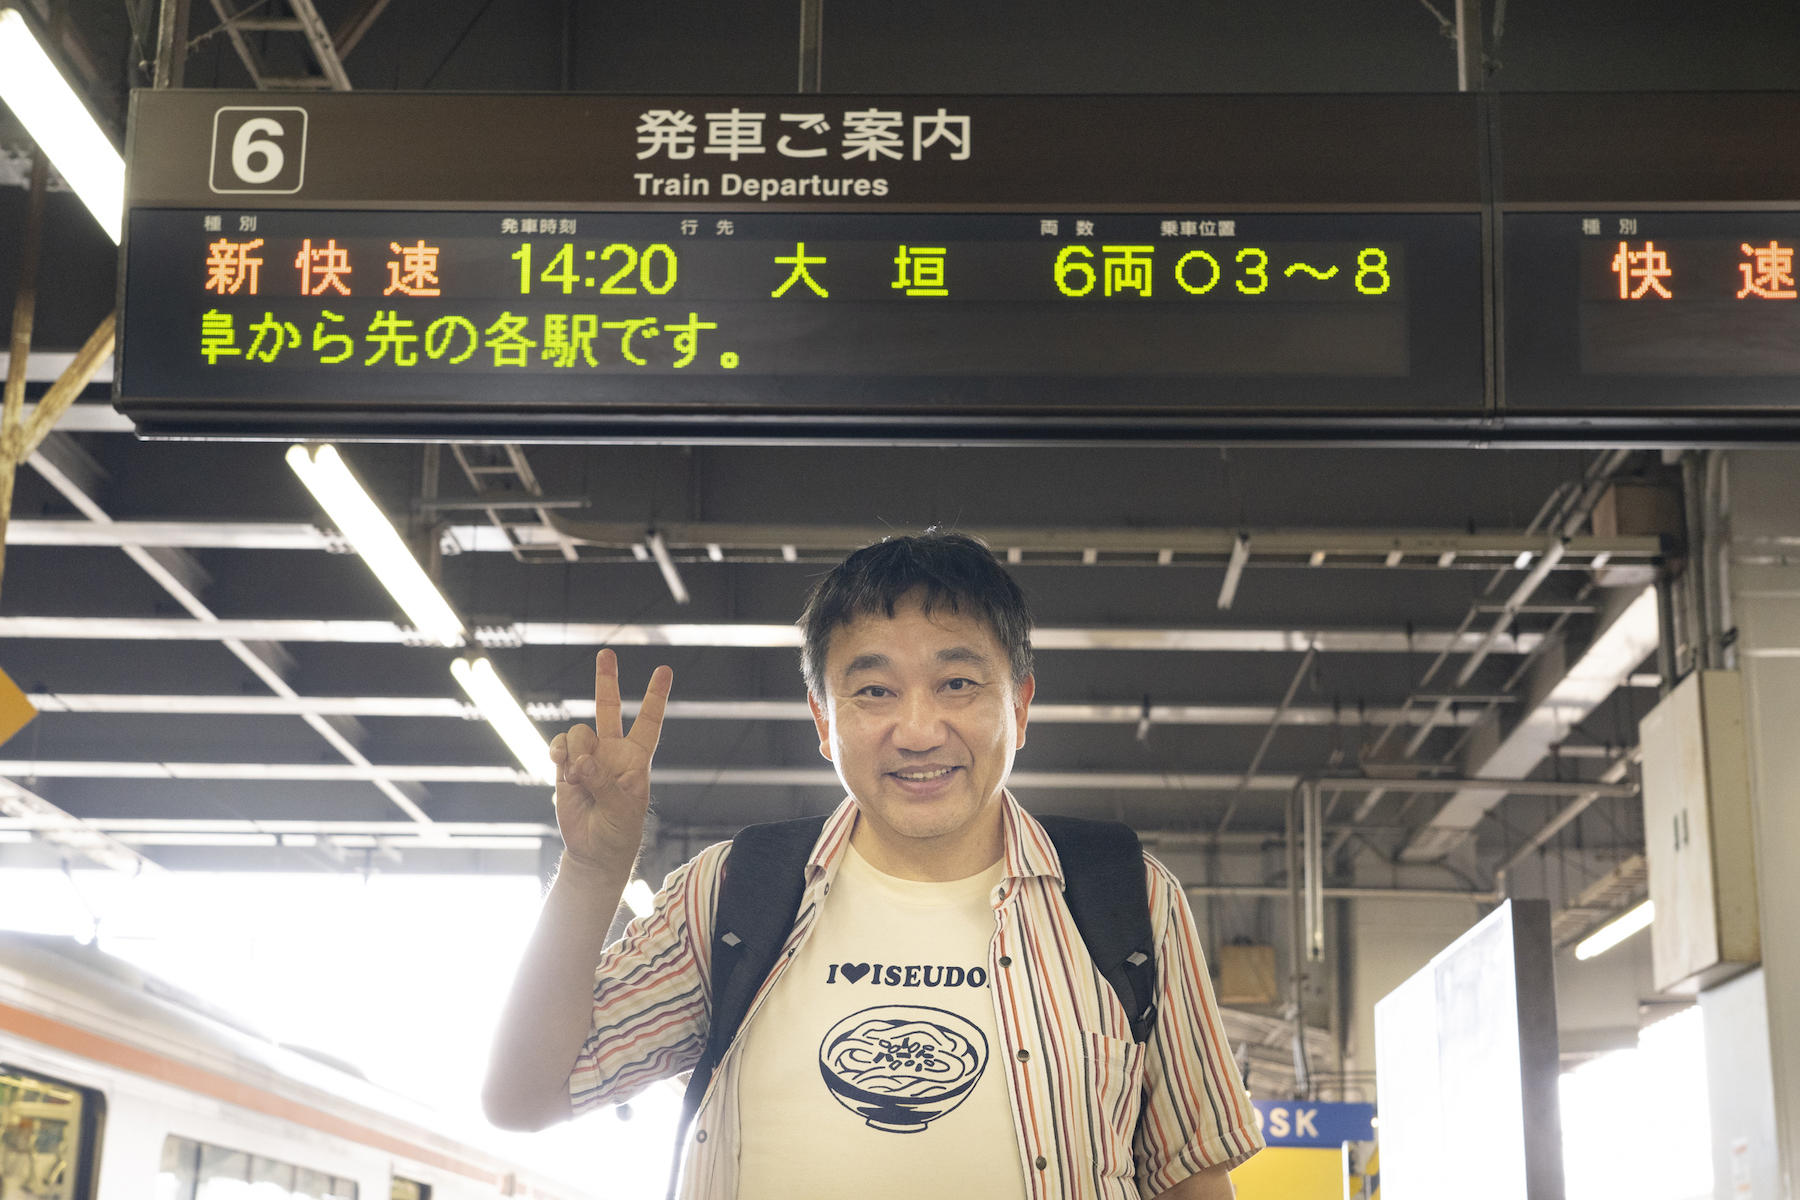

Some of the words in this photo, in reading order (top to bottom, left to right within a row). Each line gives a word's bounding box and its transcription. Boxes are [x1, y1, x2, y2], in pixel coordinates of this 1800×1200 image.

[231, 117, 285, 184] 6
[635, 108, 972, 162] 発車ご案内
[634, 173, 710, 196] Train
[721, 173, 889, 202] Departures
[500, 218, 577, 235] 発車時刻
[1160, 220, 1236, 237] 乗車位置
[511, 242, 678, 295] 14:20
[871, 963, 990, 989] ISEUDO
